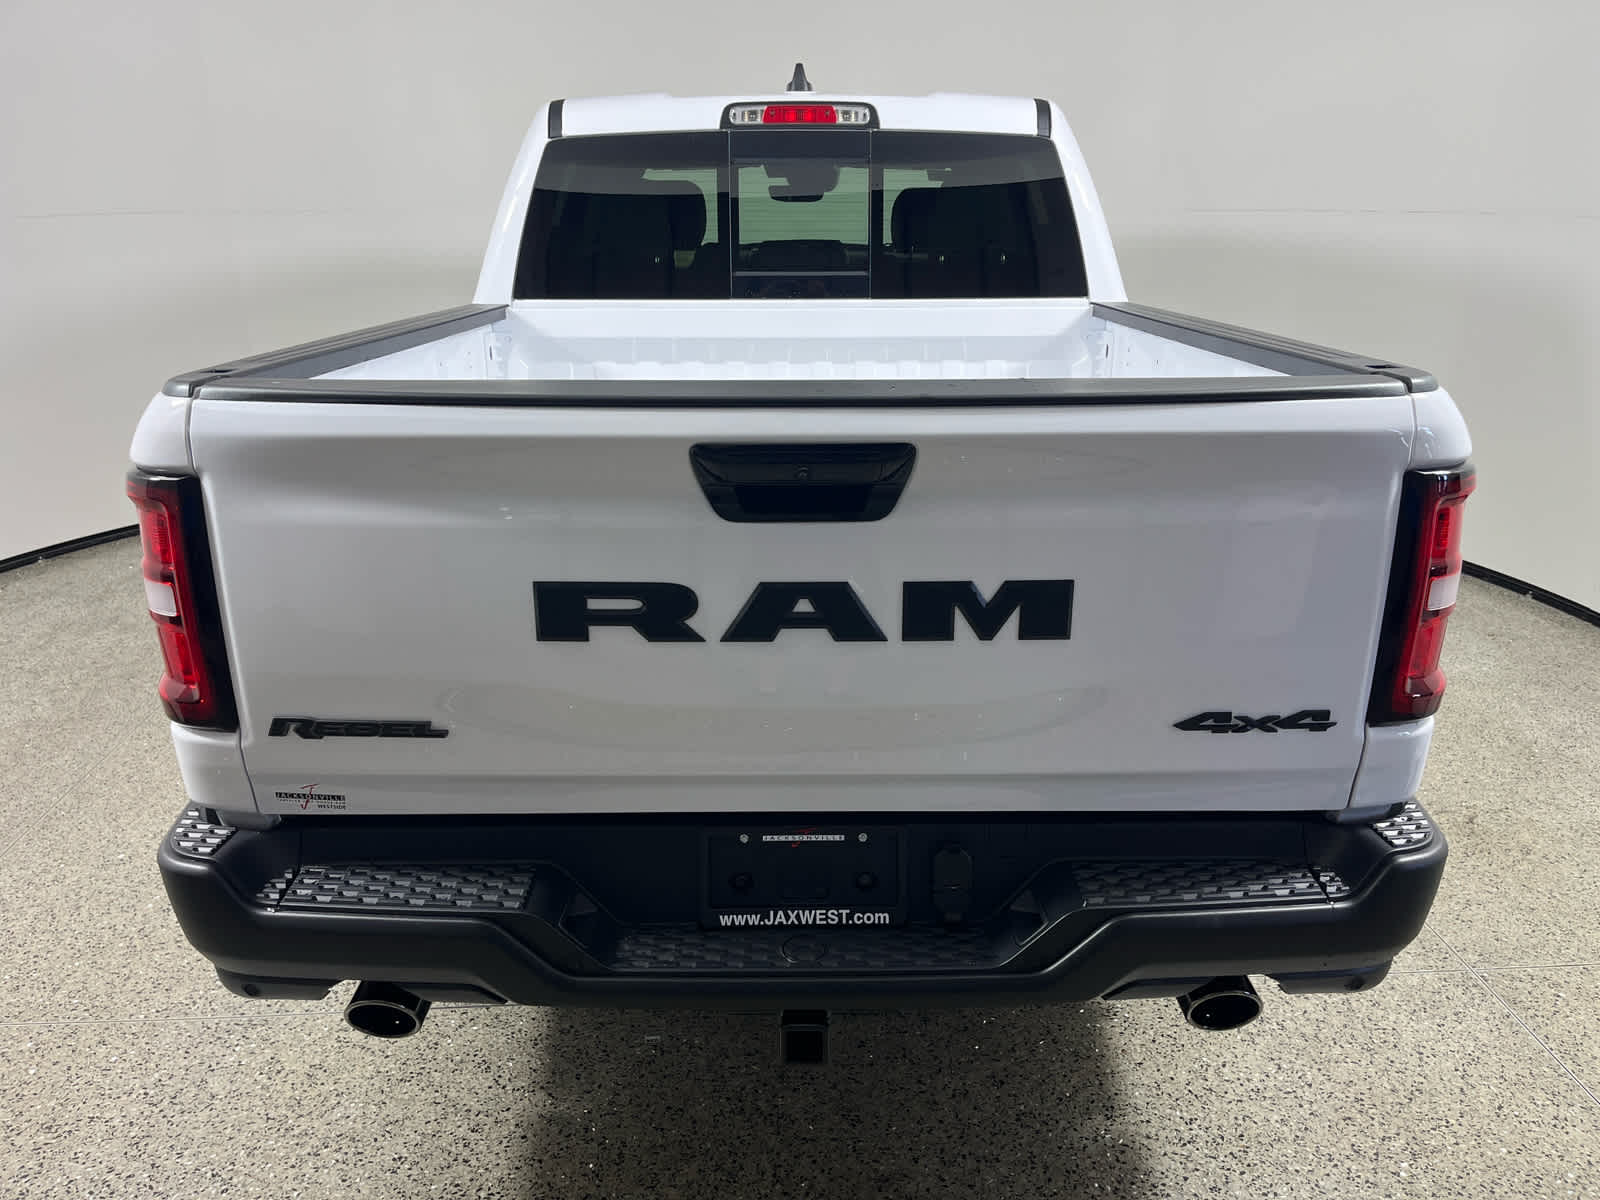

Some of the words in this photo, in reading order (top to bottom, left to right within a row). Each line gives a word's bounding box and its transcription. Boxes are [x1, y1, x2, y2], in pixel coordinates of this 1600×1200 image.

[533, 579, 1075, 643] RAM
[268, 717, 449, 739] REBEL
[1172, 709, 1337, 734] 4x4
[275, 791, 346, 802] JACKSONVILLE
[762, 834, 845, 842] JACKSONVILLE
[719, 909, 890, 926] www.JAXWEST.com
